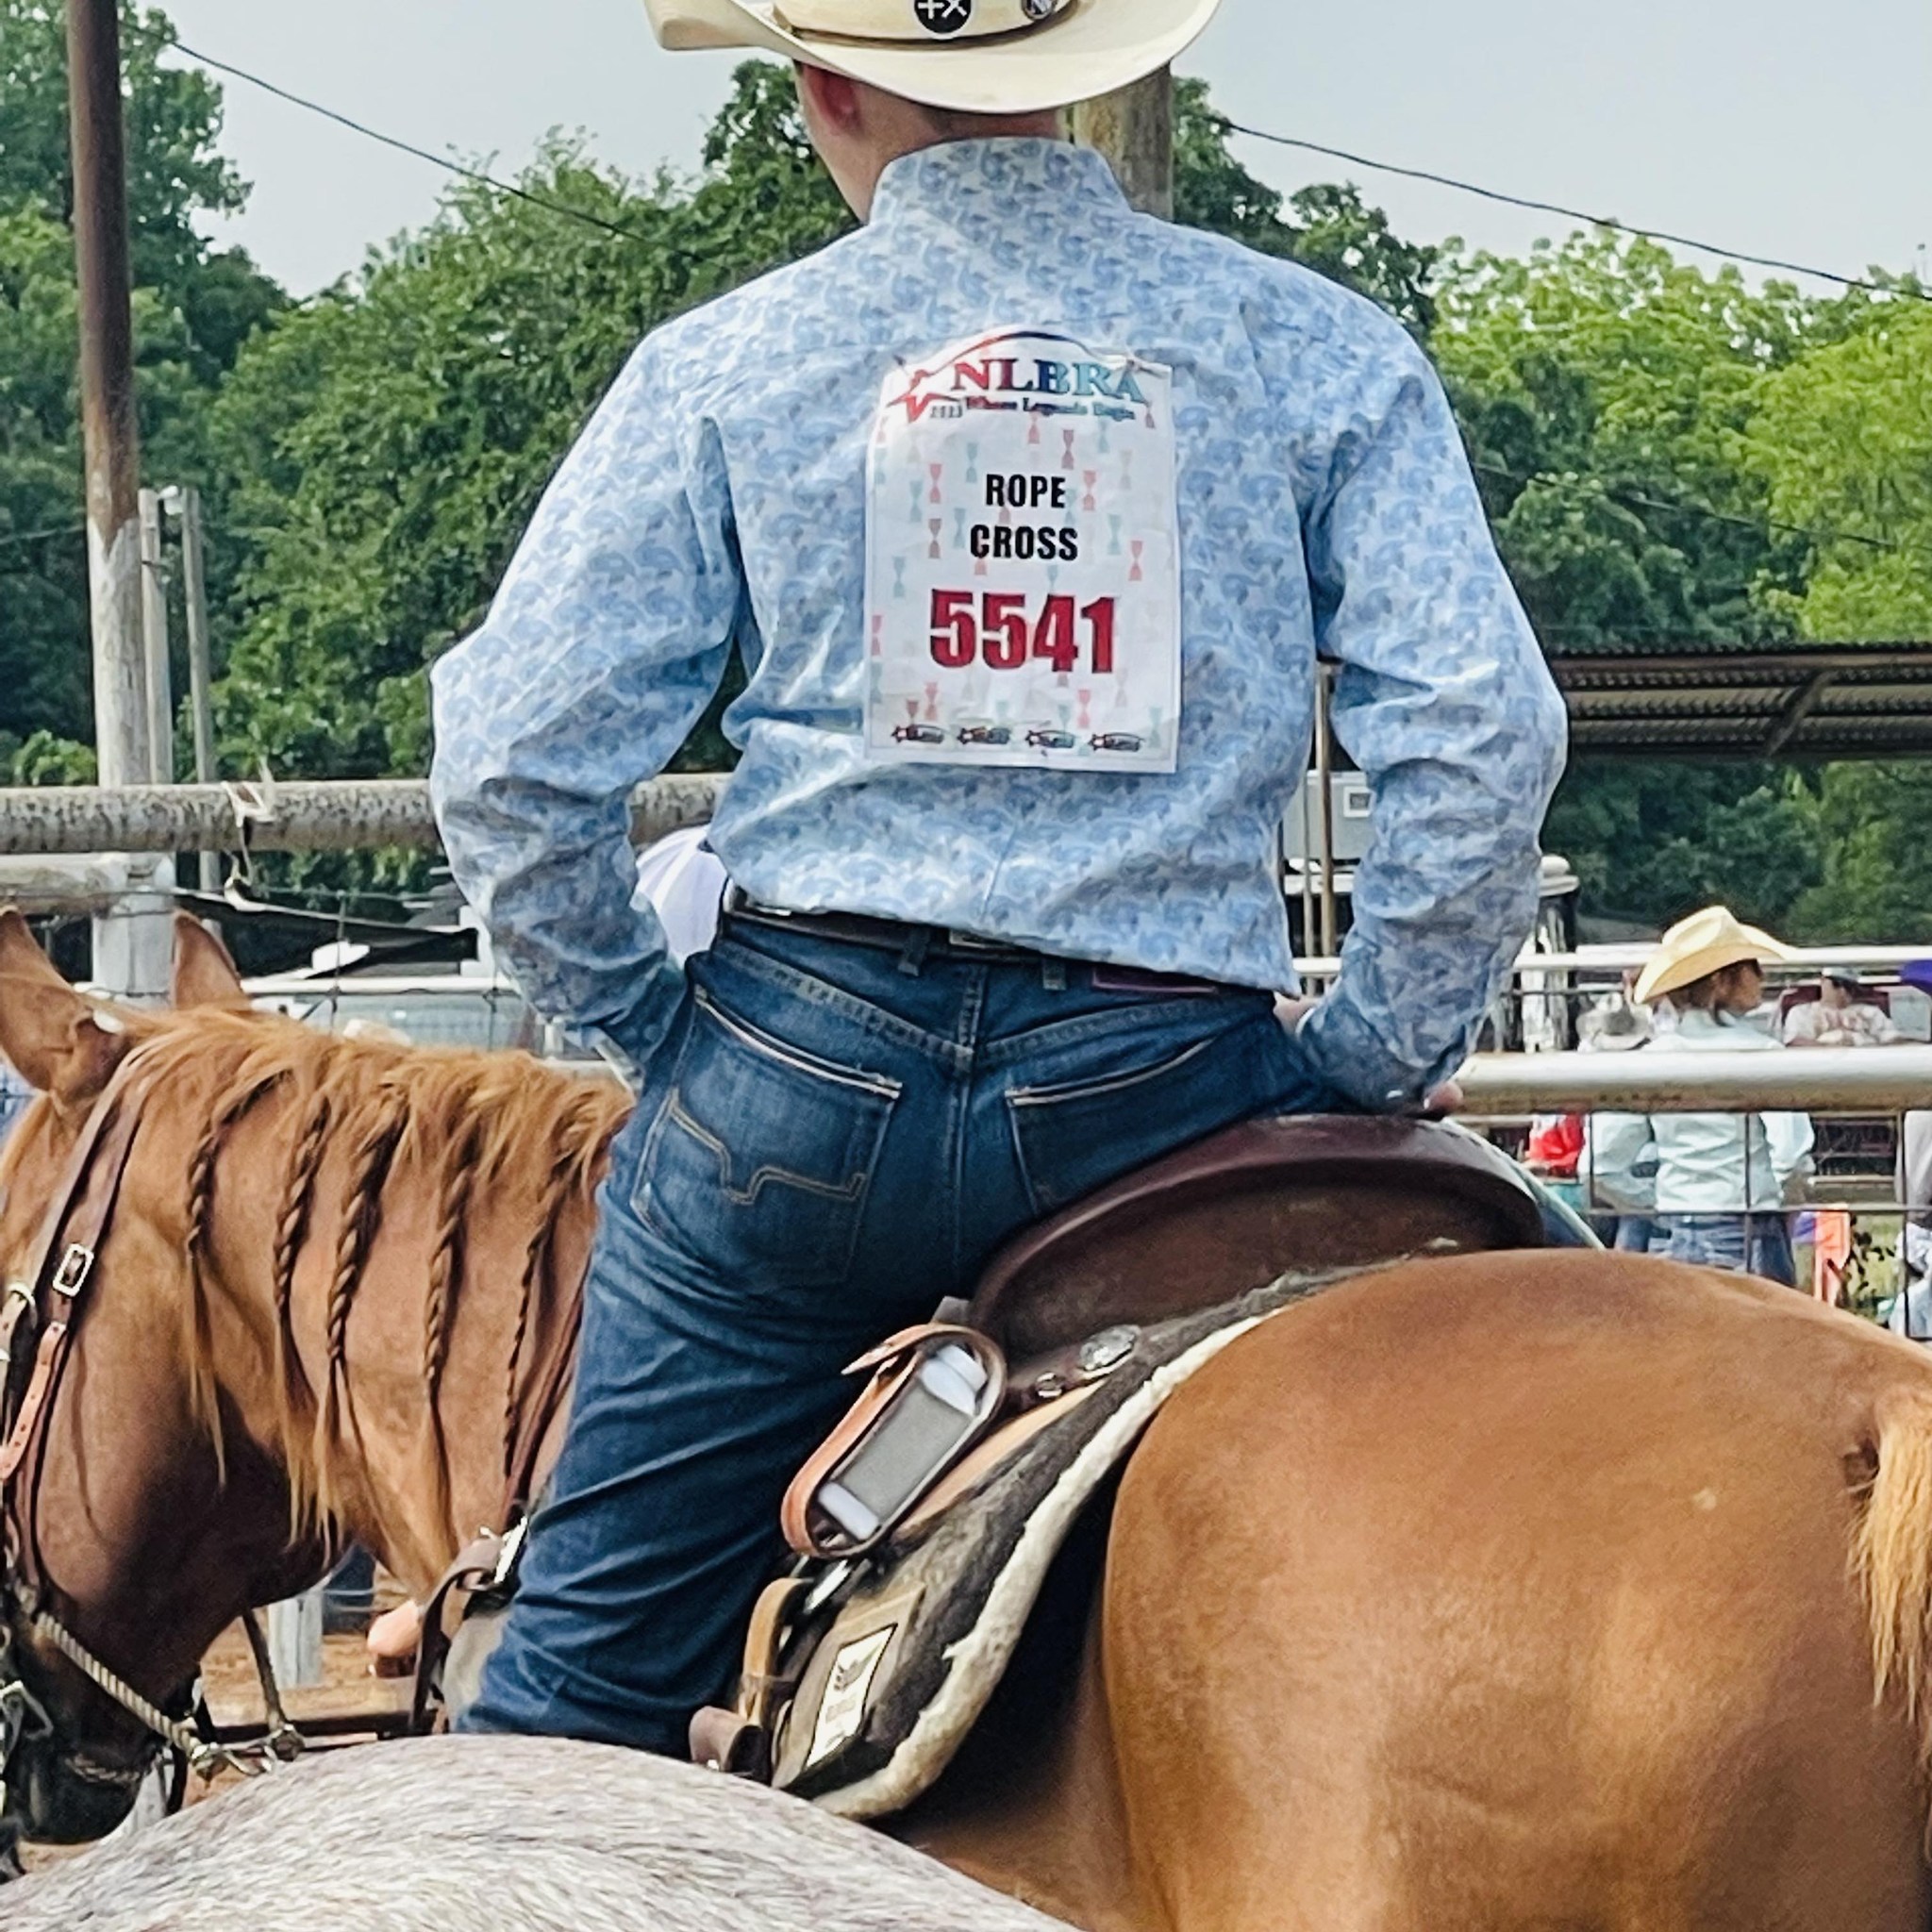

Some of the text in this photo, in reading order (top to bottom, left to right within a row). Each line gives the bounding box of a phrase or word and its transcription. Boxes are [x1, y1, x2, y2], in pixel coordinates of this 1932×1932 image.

[950, 358, 1148, 403] NLBRA
[985, 474, 1066, 508] ROPE
[970, 524, 1078, 561] CROSS
[929, 588, 1115, 674] 5541
